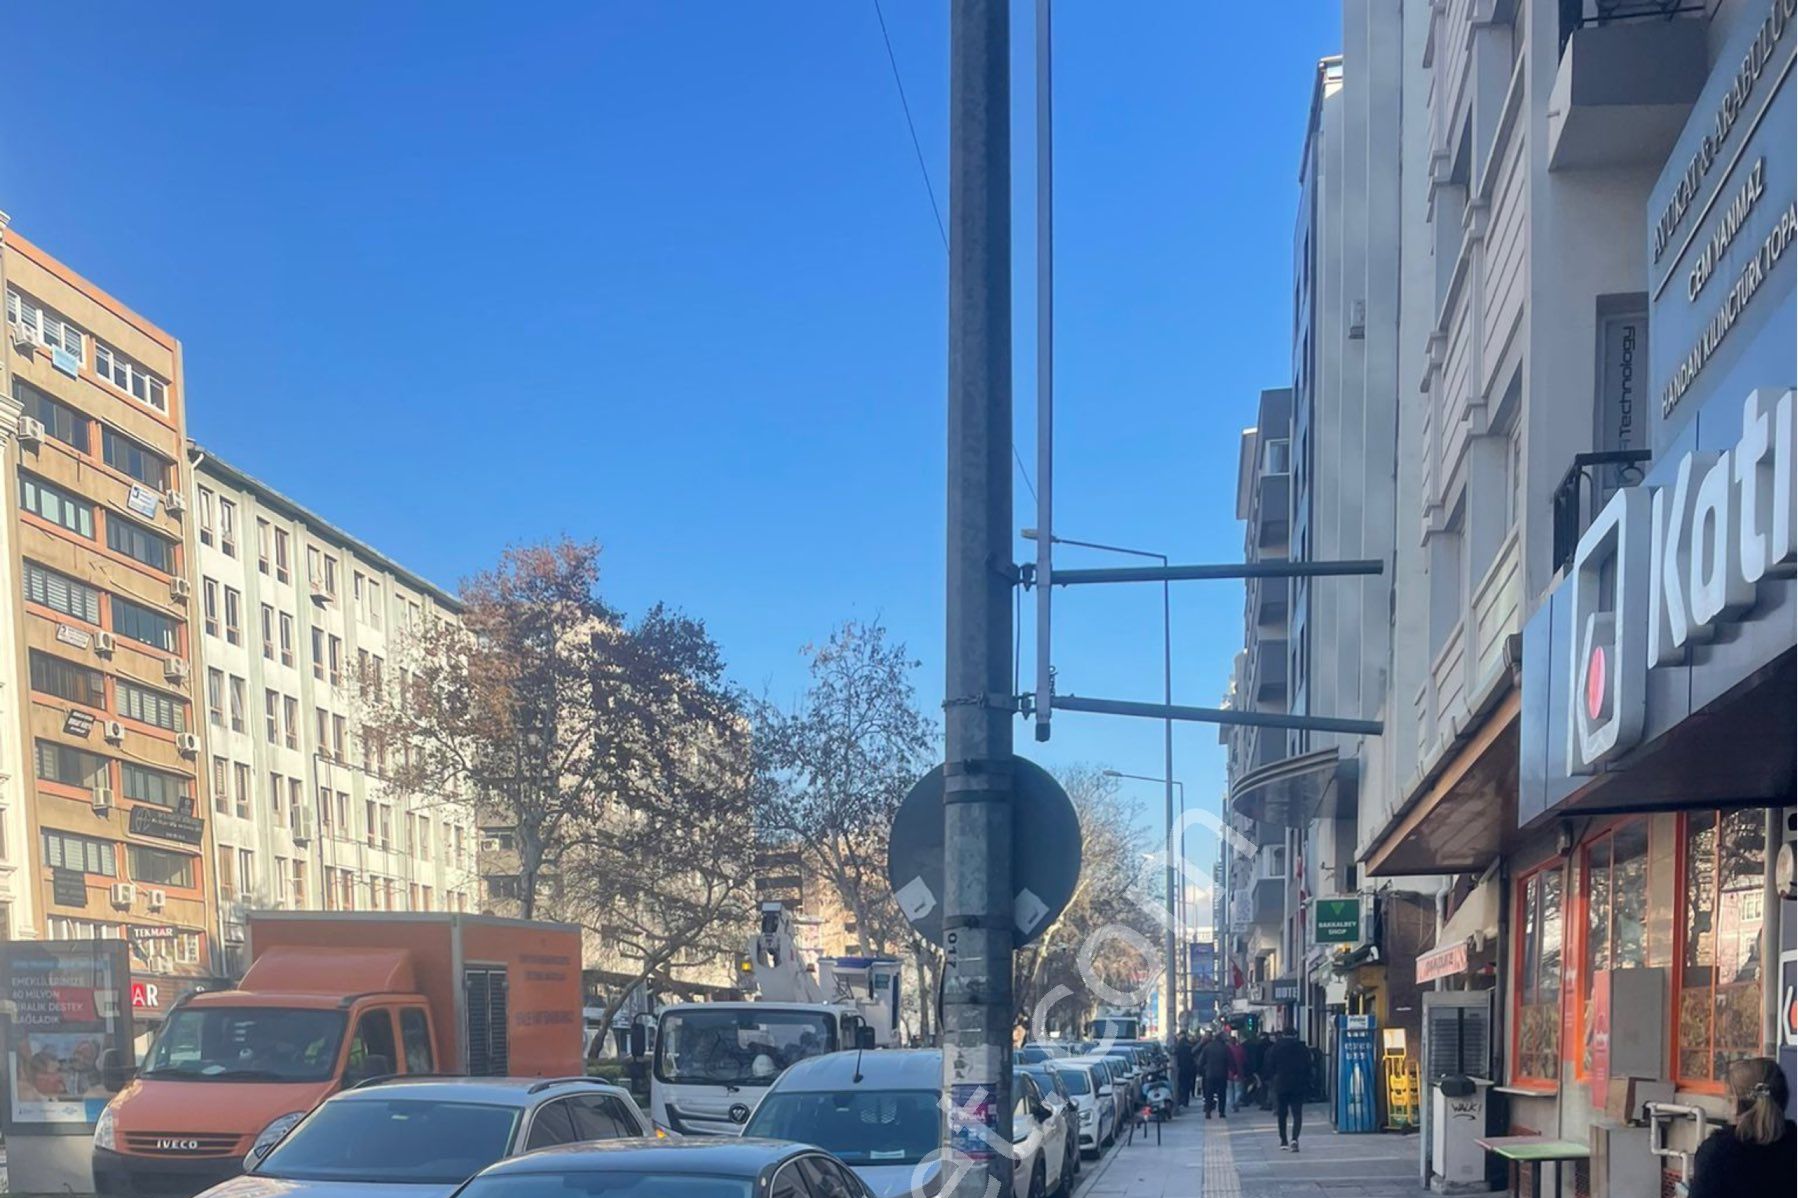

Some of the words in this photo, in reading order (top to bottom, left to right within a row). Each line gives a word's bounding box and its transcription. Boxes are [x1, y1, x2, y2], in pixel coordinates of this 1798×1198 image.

[1653, 151, 1700, 264] AVUKAT
[1688, 243, 1713, 302] CEM
[1713, 157, 1766, 262] YANMAZ
[1619, 326, 1636, 438] Technology
[1661, 340, 1703, 420] HANDAN
[134, 928, 173, 938] TEKMAR
[157, 1139, 198, 1149] IVECO
